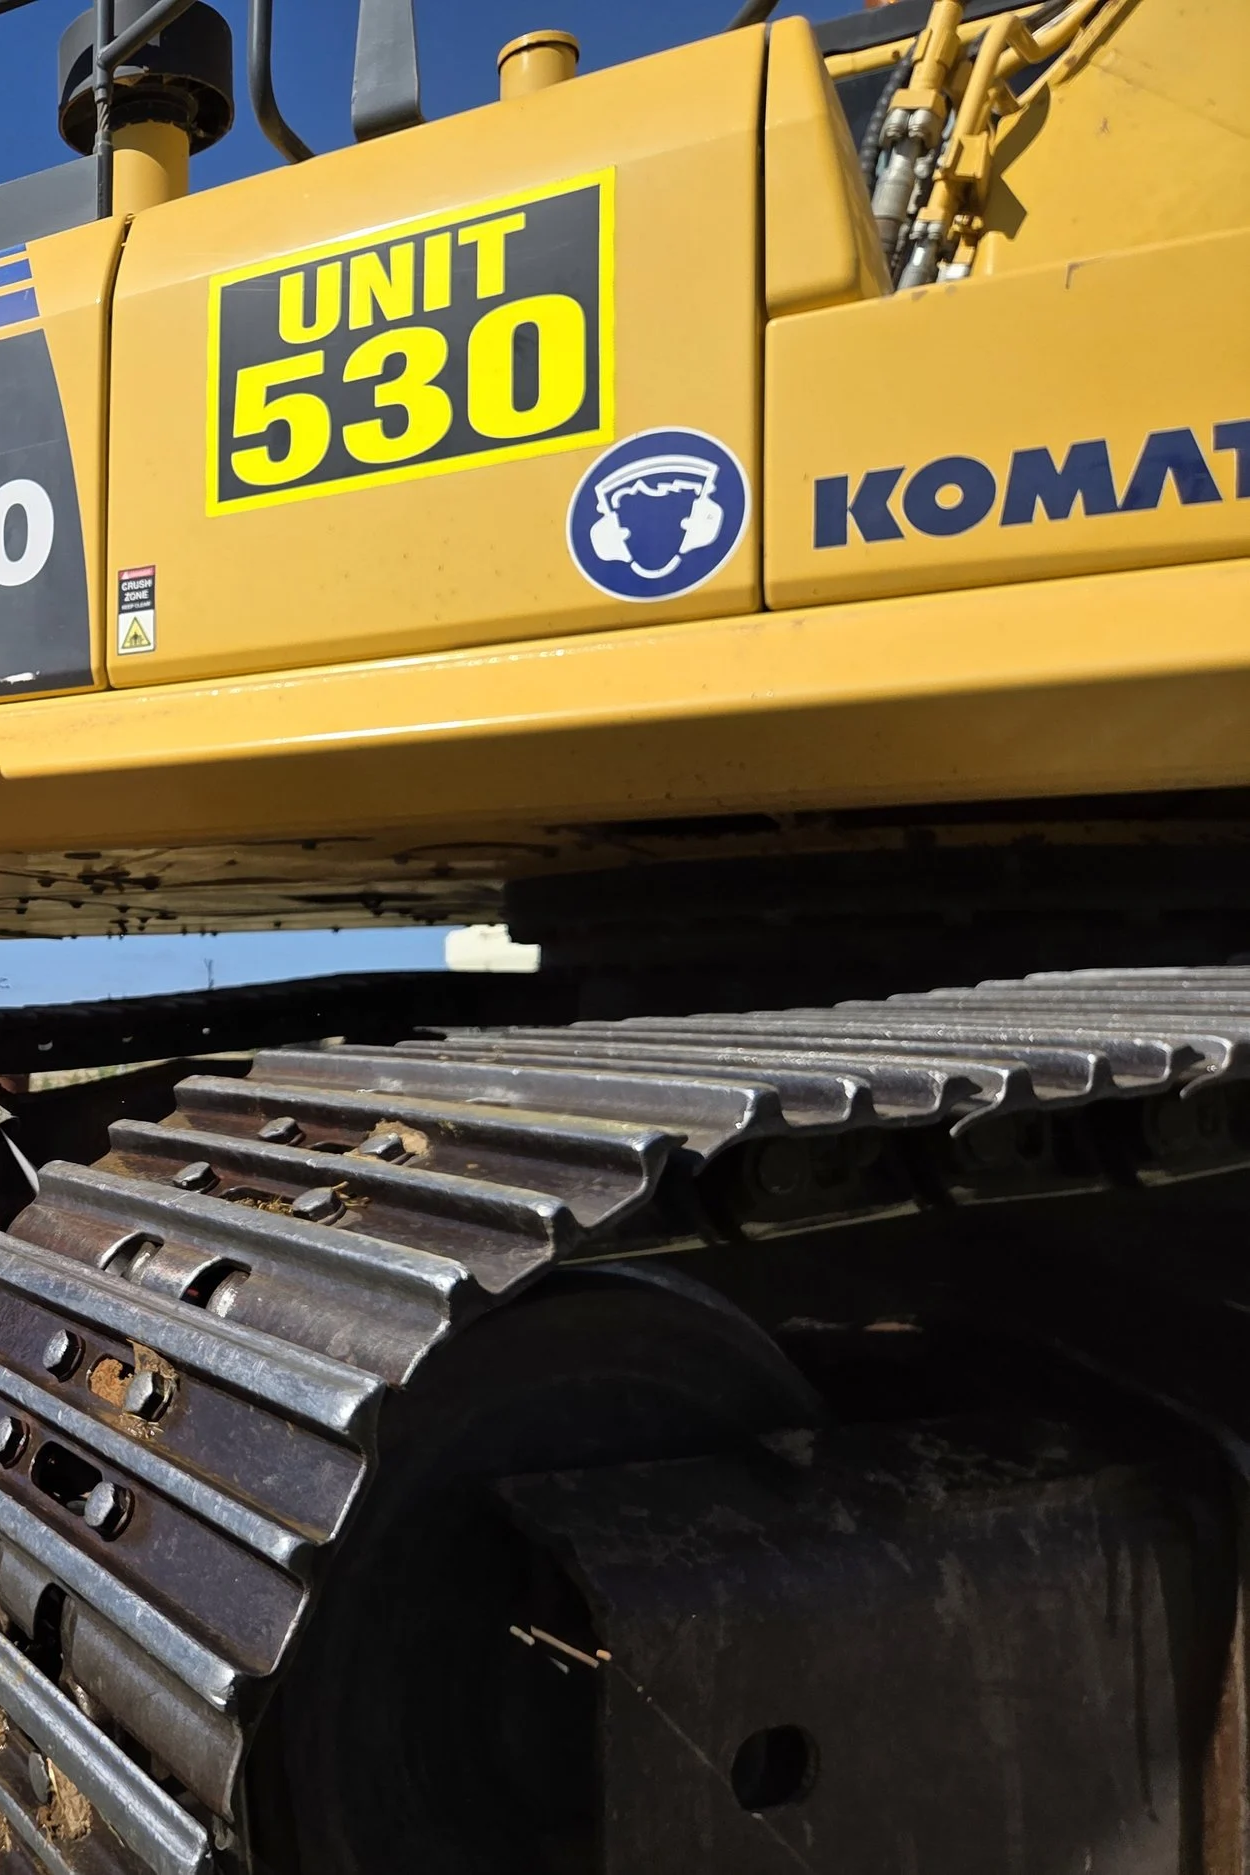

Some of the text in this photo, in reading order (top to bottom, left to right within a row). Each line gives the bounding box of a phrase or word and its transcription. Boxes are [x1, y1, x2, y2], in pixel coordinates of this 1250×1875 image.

[279, 212, 526, 344] UNIT
[230, 294, 586, 486] 530
[121, 579, 152, 591] CRUSH
[124, 590, 149, 602] ZONE
